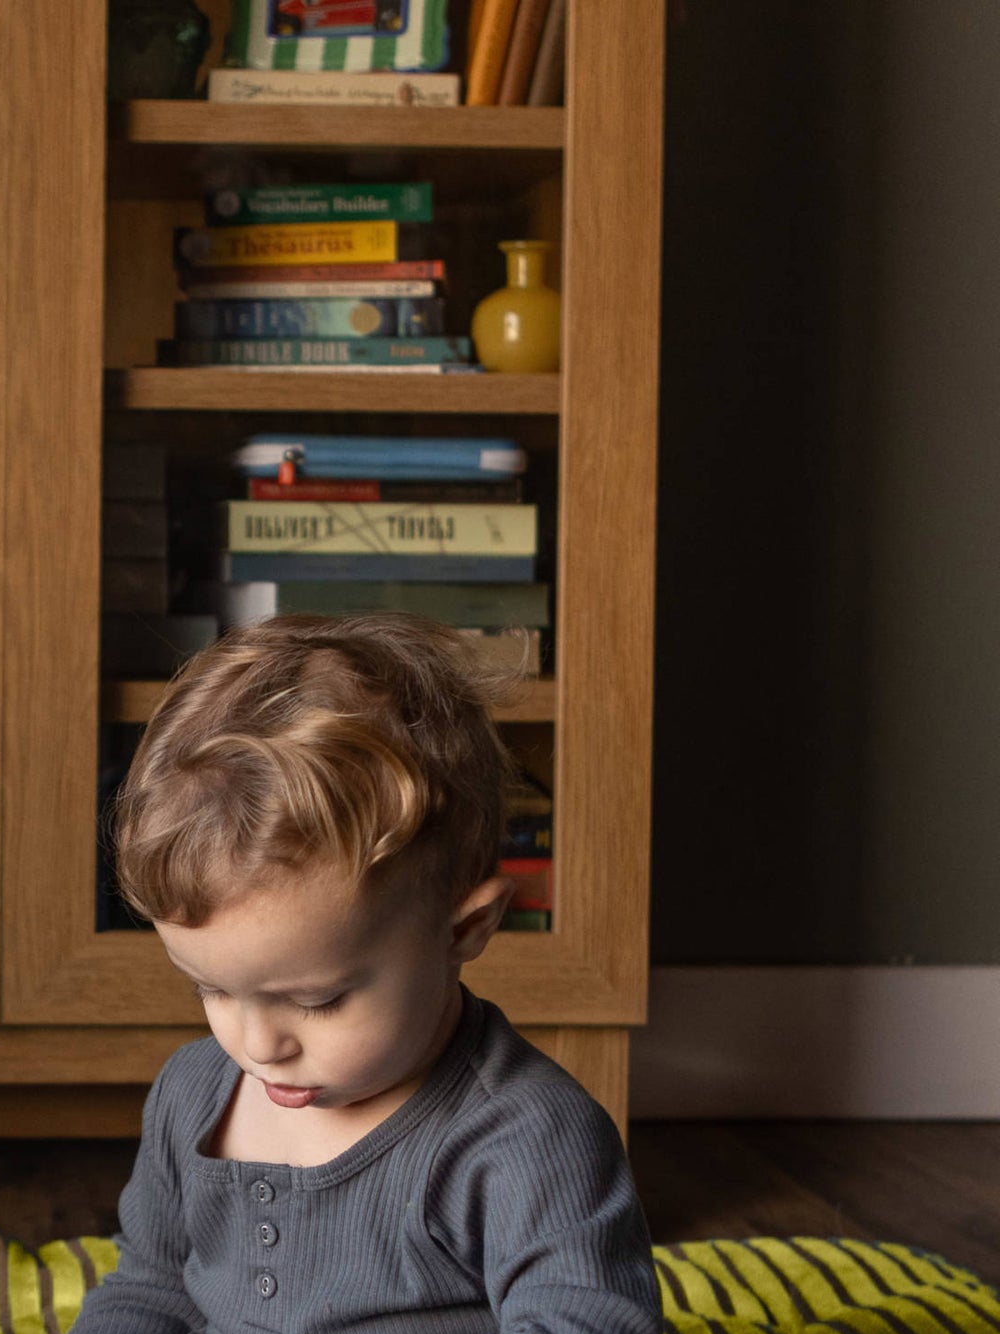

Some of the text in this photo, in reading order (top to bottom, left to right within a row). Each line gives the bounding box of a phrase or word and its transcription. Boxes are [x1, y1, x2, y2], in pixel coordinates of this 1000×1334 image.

[248, 196, 389, 214] Vocabulary Builder
[229, 236, 355, 258] Thesaurus
[302, 341, 350, 364] BOOK
[386, 515, 456, 540] TRAVELS
